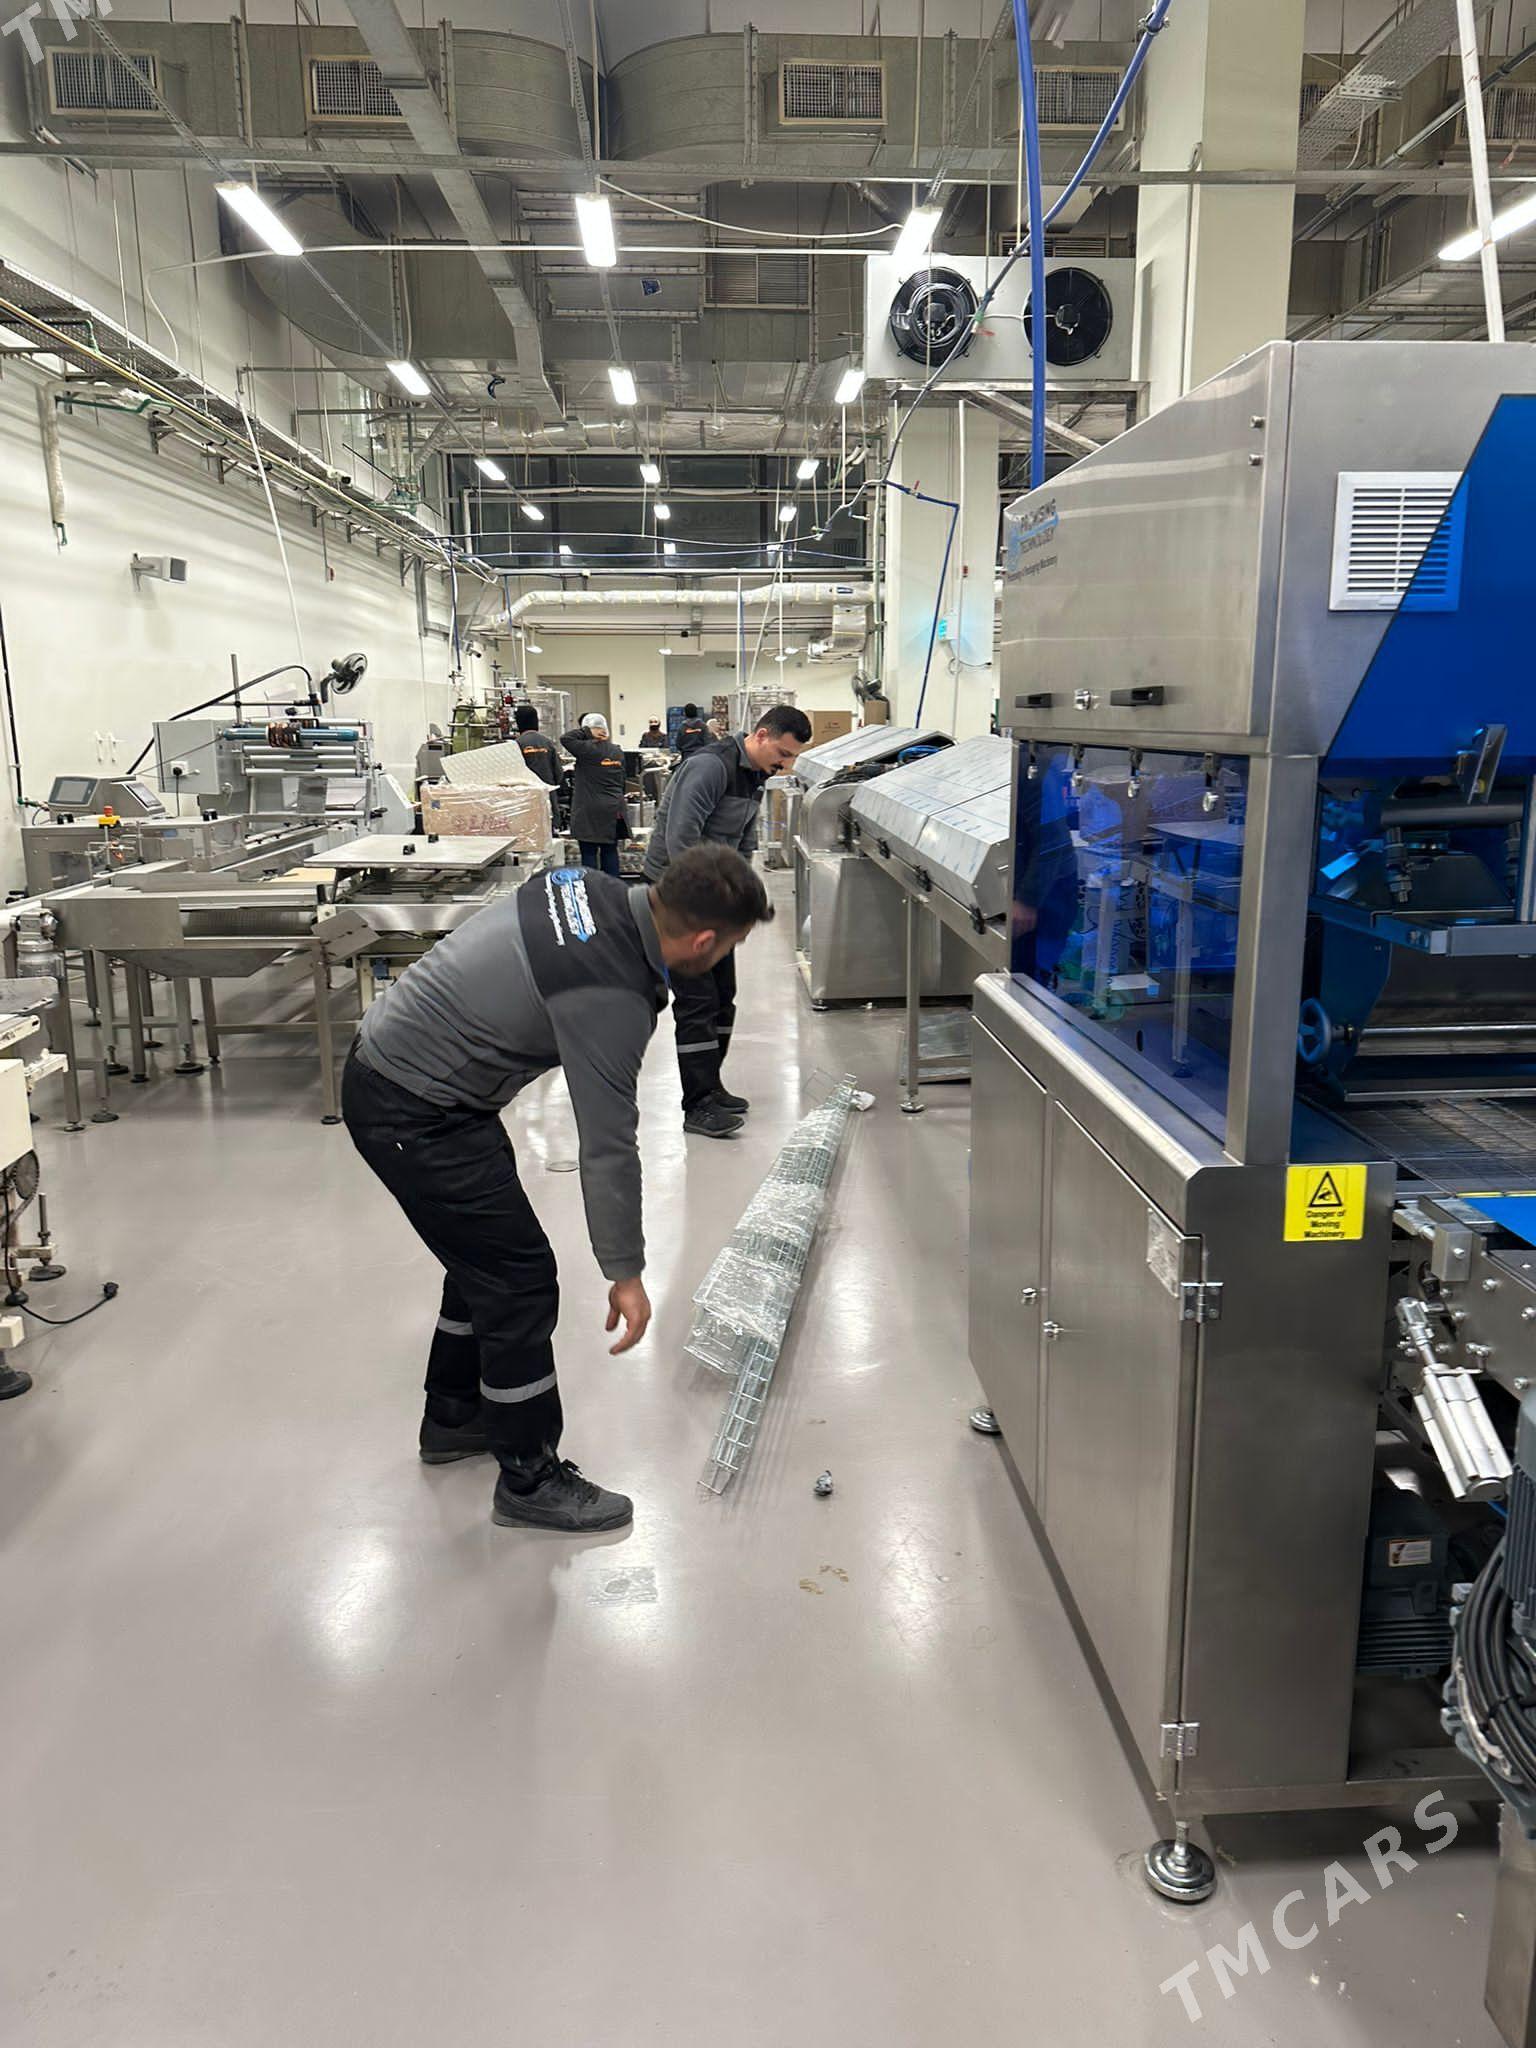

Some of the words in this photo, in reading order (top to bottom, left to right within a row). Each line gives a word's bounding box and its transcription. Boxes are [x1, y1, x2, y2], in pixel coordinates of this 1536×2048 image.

[1306, 1210, 1335, 1219] Danger
[1337, 1209, 1346, 1217] of
[1310, 1220, 1340, 1229] Moving
[1304, 1230, 1345, 1238] Machinery
